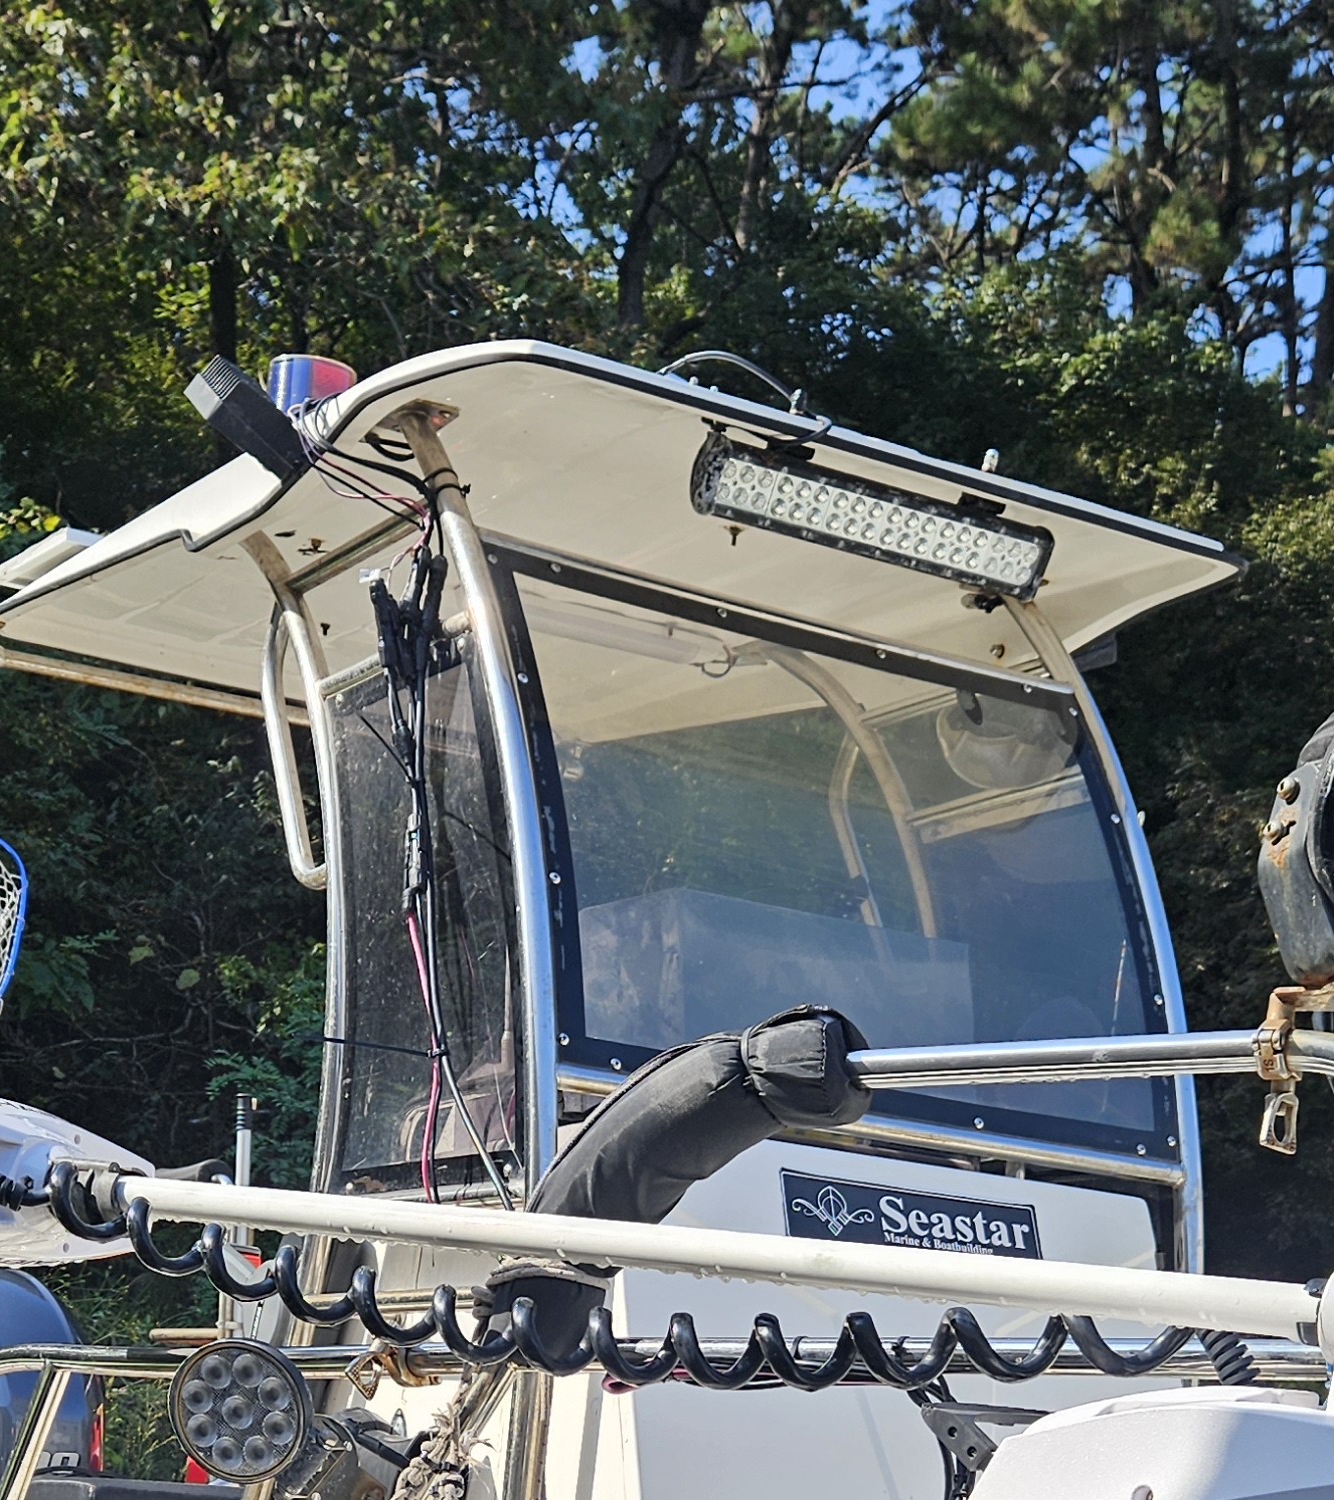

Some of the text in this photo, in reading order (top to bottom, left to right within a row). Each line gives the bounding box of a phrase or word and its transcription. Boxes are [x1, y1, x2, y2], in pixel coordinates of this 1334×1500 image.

[878, 1195, 1030, 1250] Seastar
[884, 1231, 920, 1247] Marine
[921, 1237, 932, 1248] &
